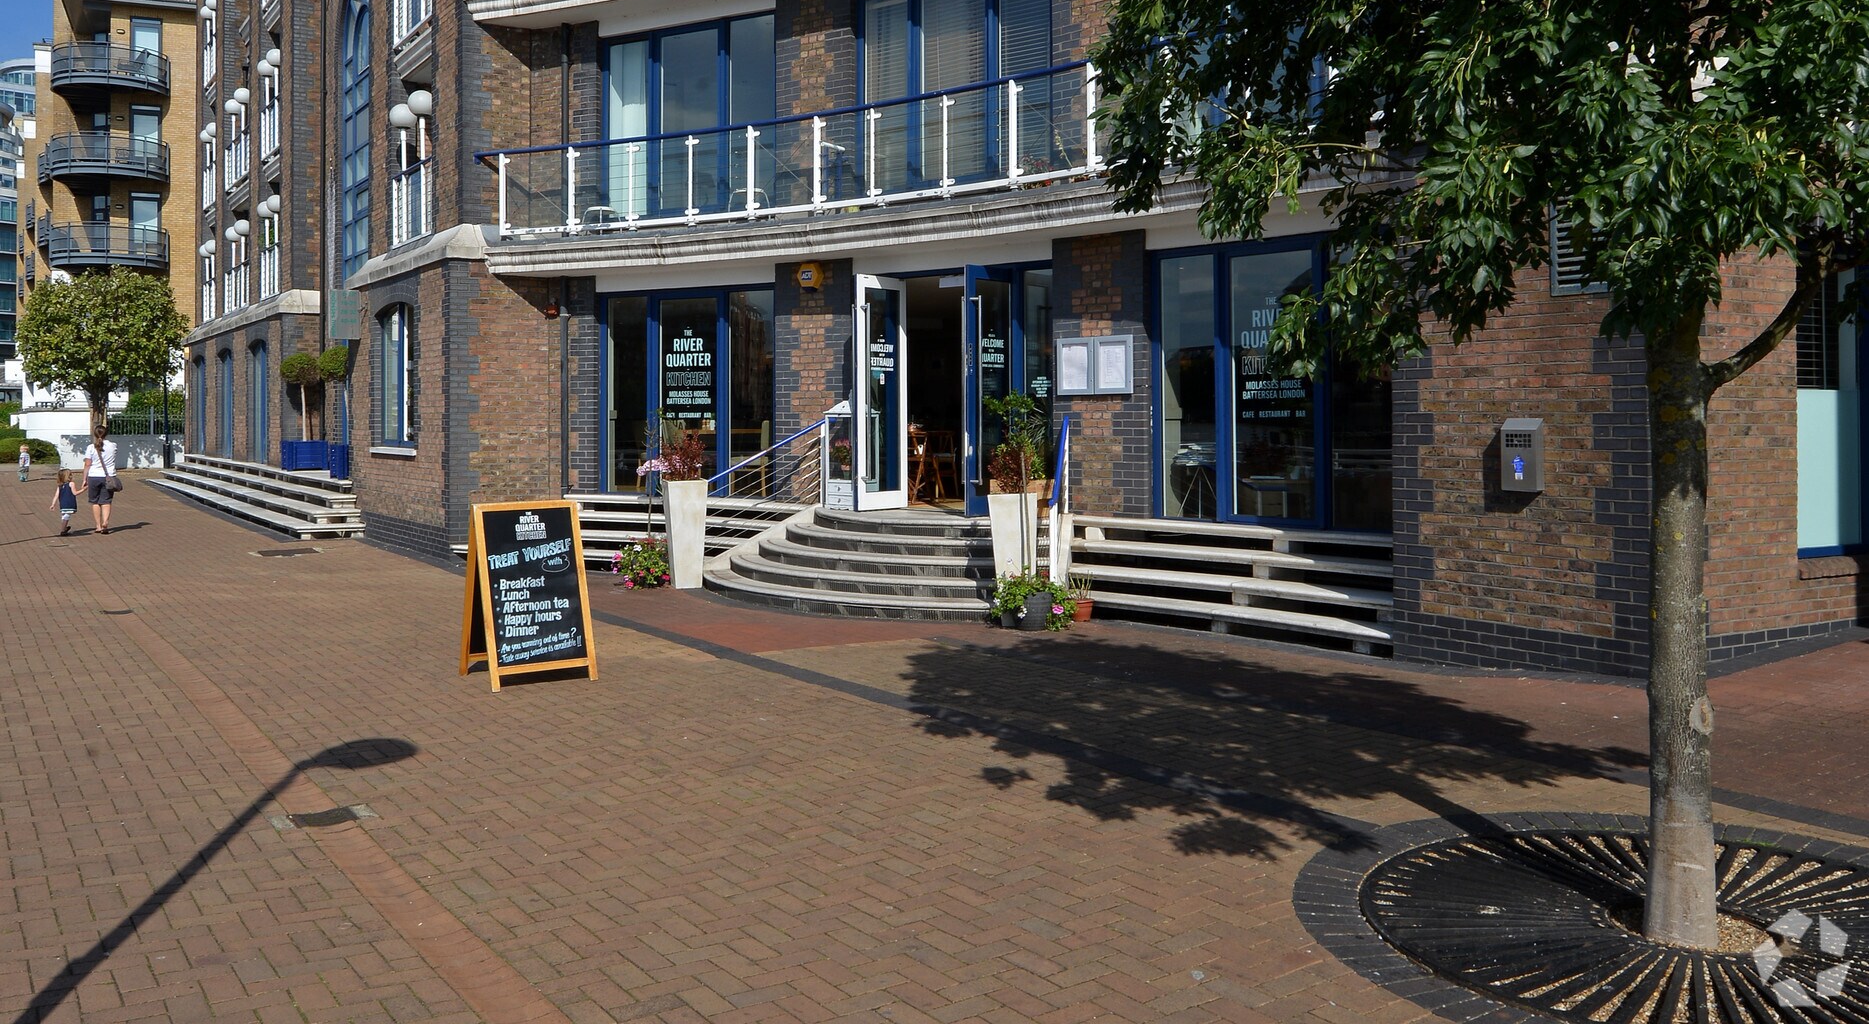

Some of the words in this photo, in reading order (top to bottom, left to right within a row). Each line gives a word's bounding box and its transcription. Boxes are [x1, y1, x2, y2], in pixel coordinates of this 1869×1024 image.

[1265, 297, 1277, 305] THE
[673, 338, 703, 352] RIVER
[666, 353, 711, 367] QUARTER
[666, 372, 711, 386] KITCHEN
[1246, 380, 1279, 390] MOLASSES
[1280, 379, 1302, 389] HOUSE
[1242, 390, 1277, 400] BATTERSEA
[1279, 389, 1306, 399] LONDON
[519, 515, 539, 523] RIVER
[515, 523, 546, 532] QUARTER
[488, 551, 519, 570] TREAT
[522, 538, 572, 562] YOURSELF
[547, 556, 563, 566] with
[501, 589, 530, 601] Lunch
[553, 597, 569, 608] tea
[504, 613, 532, 626] Happy
[535, 611, 562, 623] hours
[505, 625, 539, 637] Dinner
[501, 643, 510, 653] Are
[511, 643, 521, 652] you
